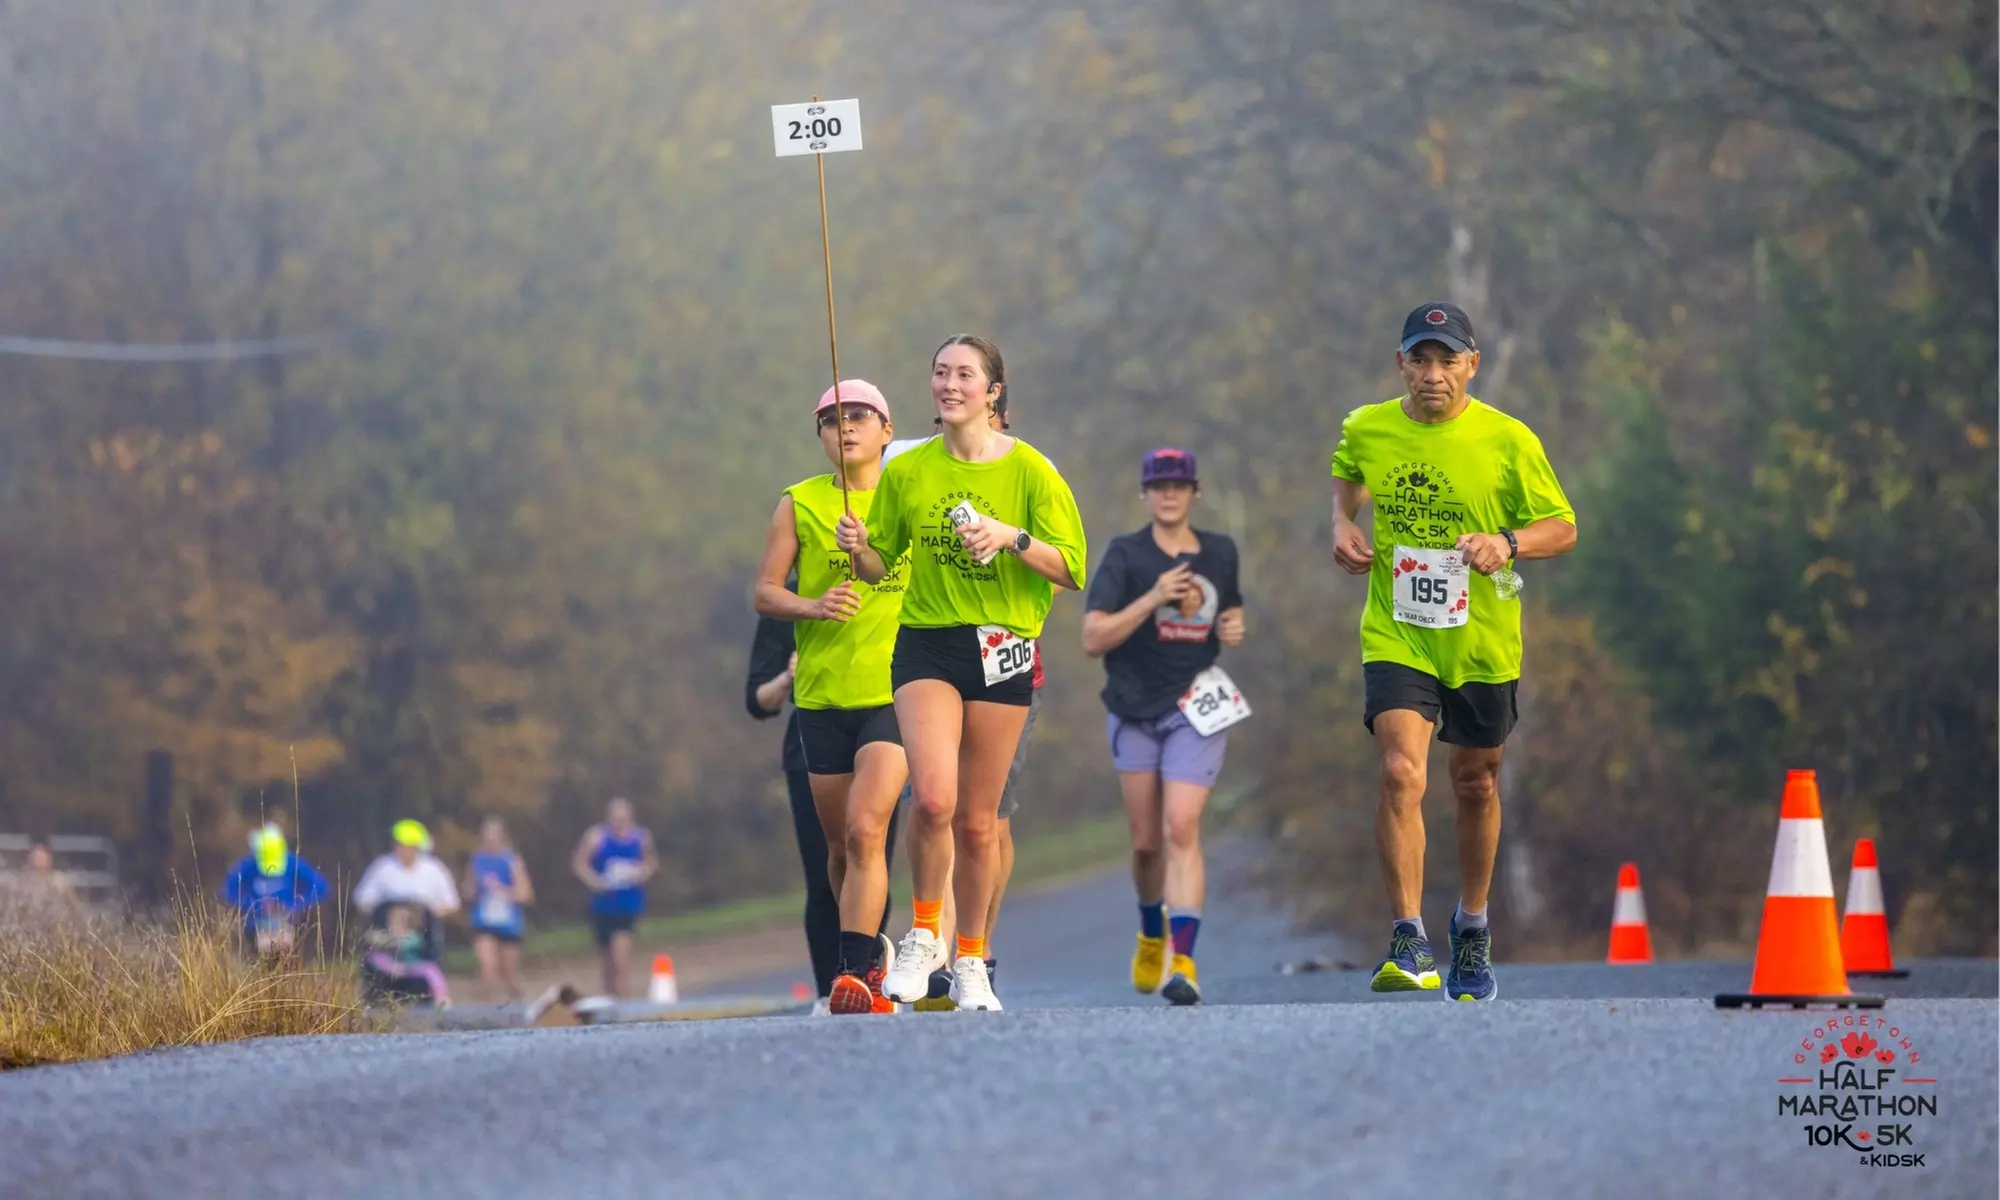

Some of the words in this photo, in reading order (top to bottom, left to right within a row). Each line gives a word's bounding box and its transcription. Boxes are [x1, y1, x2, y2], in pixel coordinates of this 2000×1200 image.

[788, 117, 842, 140] 2:00
[1382, 462, 1455, 494] GEORGETOWN
[928, 492, 1000, 520] GEORGETOW
[1395, 487, 1440, 506] HALF
[1389, 521, 1427, 539] 10K
[1428, 524, 1450, 538] 5K
[933, 553, 970, 570] 10K
[1411, 576, 1449, 604] 195
[996, 638, 1031, 674] 206
[1192, 685, 1231, 717] 284
